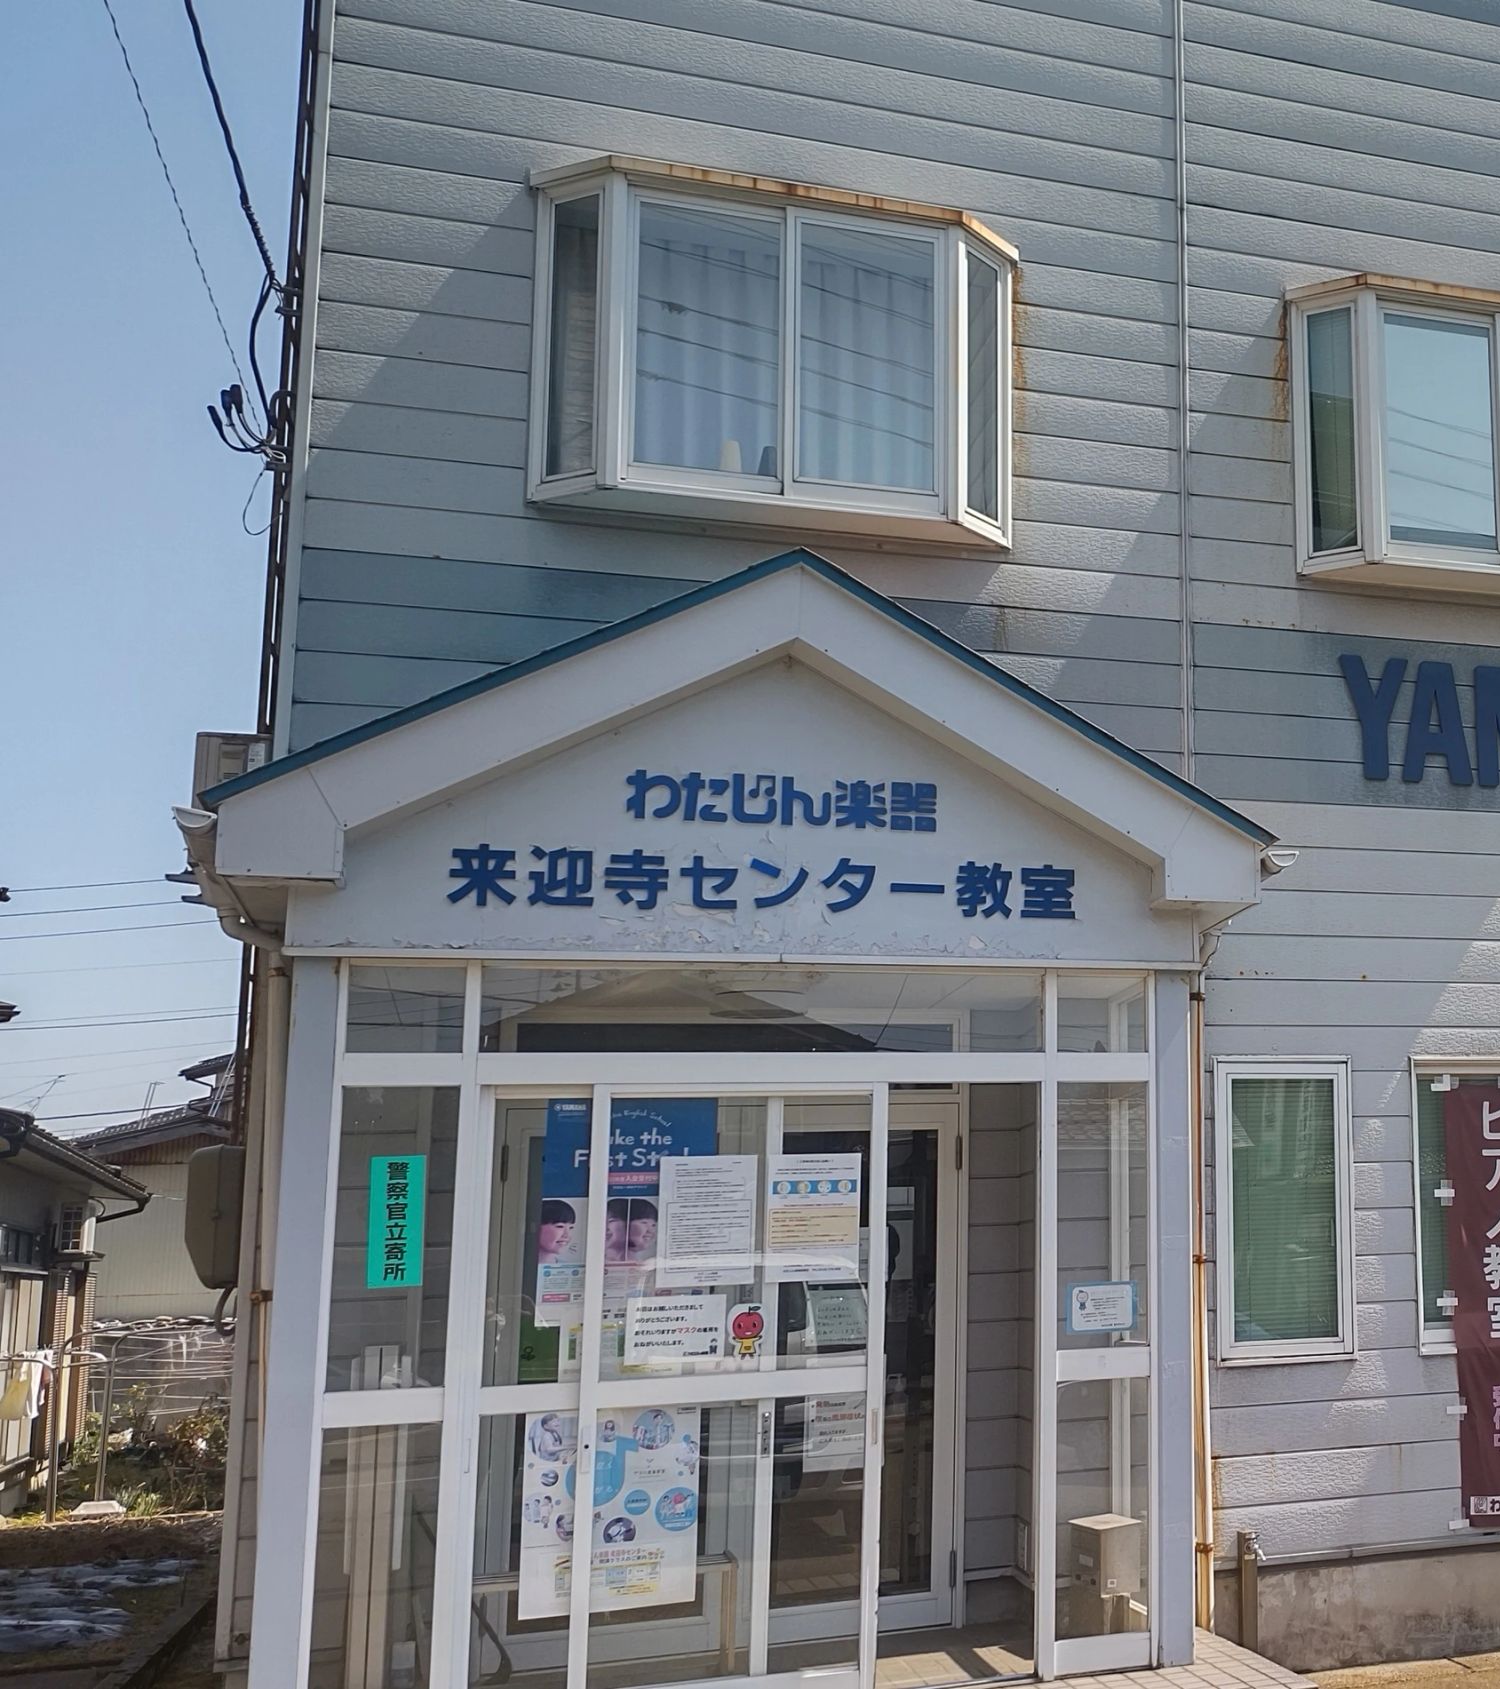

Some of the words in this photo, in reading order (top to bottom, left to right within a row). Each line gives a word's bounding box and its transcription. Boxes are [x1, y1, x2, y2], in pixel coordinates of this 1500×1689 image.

[625, 768, 938, 832] わたじん楽器
[447, 842, 1077, 920] 来迎寺センター教室
[574, 1149, 628, 1168] Fst
[640, 1127, 673, 1145] the
[383, 1161, 410, 1281] 警察官立寄所
